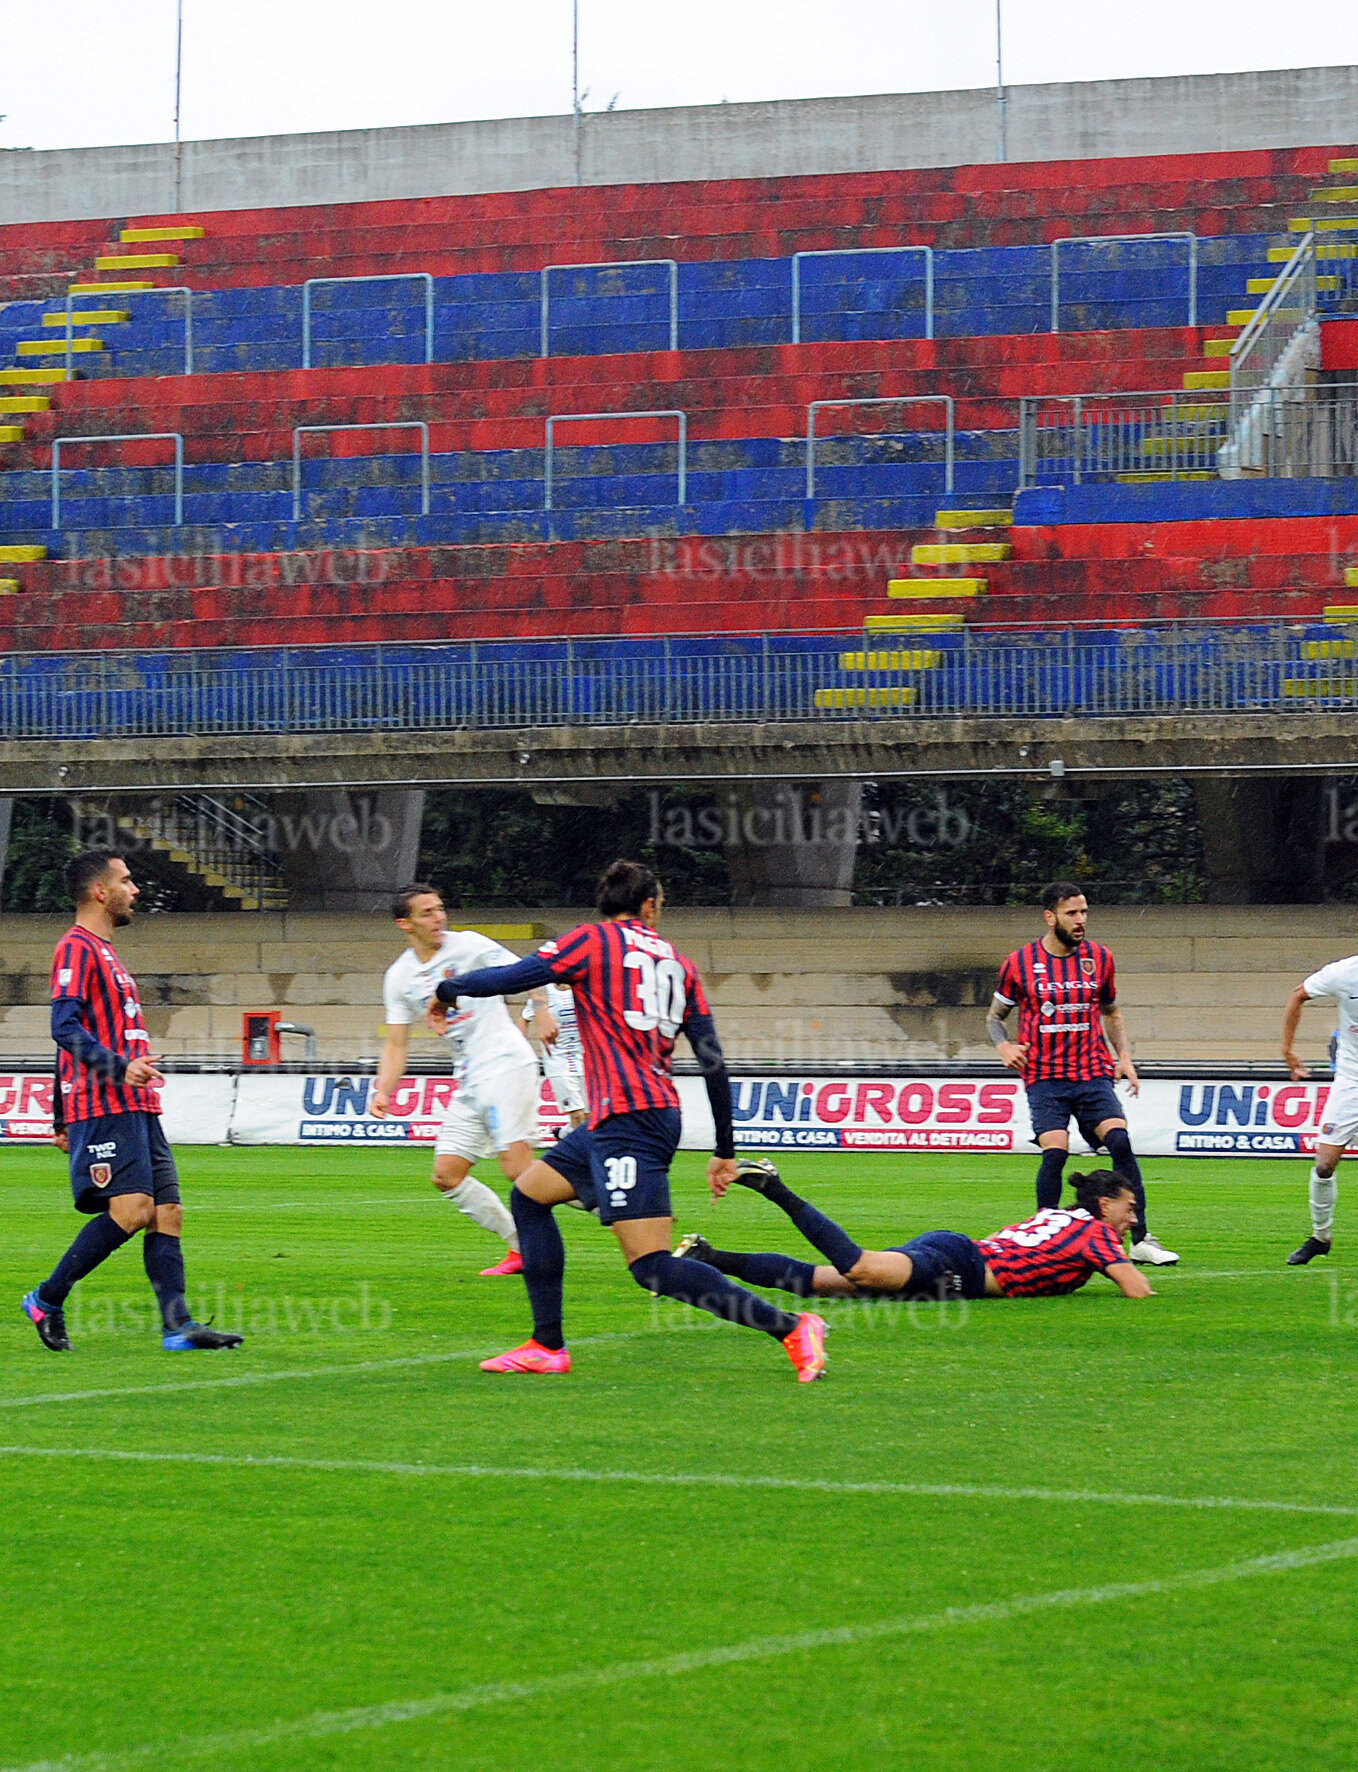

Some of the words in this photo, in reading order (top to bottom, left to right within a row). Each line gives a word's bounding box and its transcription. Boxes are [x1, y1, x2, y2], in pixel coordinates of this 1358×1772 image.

[1038, 981, 1098, 990] LEVIGAS
[623, 951, 686, 1039] 30
[302, 1124, 351, 1136] INTIMO
[352, 1124, 366, 1137] &
[366, 1125, 405, 1137] CASA
[733, 1130, 780, 1143] NTIMO
[781, 1131, 796, 1144] &
[796, 1131, 838, 1144] CASA
[844, 1132, 907, 1145] VENDITA
[908, 1133, 928, 1145] AL
[929, 1134, 1010, 1146] DETTAGLIO
[1179, 1135, 1234, 1148] INTIMO
[1235, 1136, 1251, 1149] &
[1252, 1136, 1295, 1149] CASA
[87, 1142, 116, 1153] TWO
[604, 1156, 637, 1190] 30
